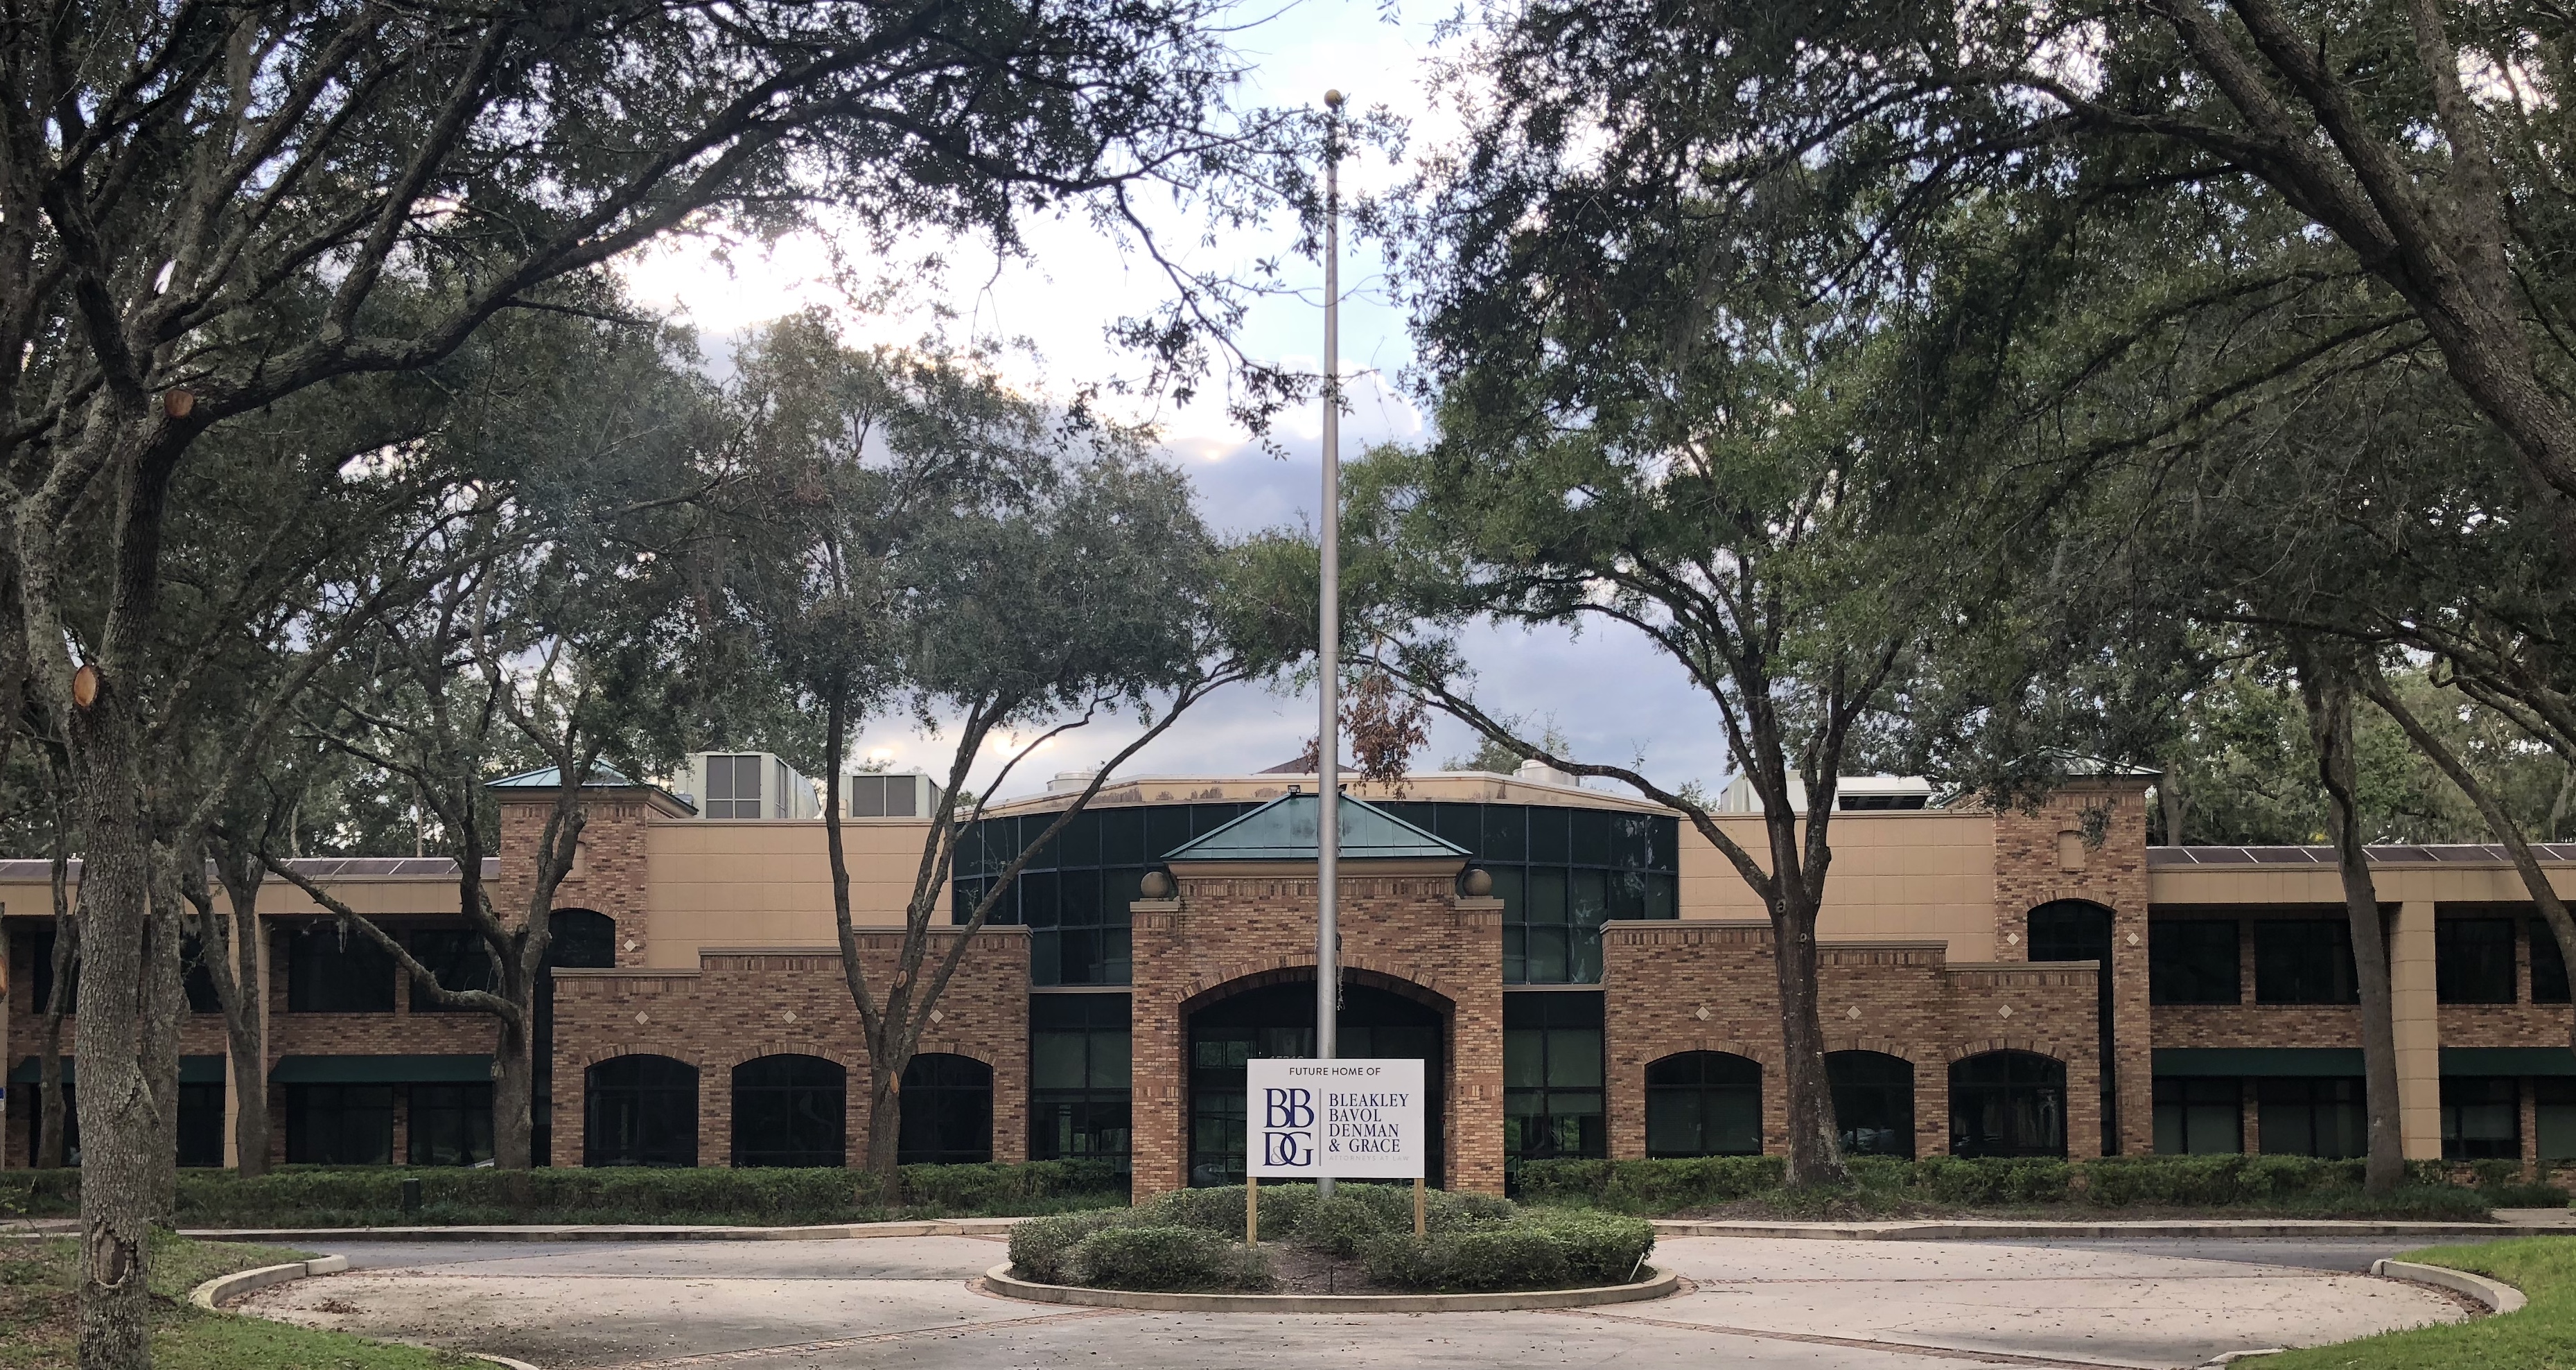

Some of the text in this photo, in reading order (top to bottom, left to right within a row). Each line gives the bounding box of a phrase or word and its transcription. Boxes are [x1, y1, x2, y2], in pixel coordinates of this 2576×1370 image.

[1289, 1067, 1381, 1075] FUTURE HOME OF
[1329, 1094, 1410, 1107] BLEAKLEY
[1263, 1088, 1315, 1128] BB
[1329, 1109, 1381, 1122] BAVOL
[1329, 1123, 1399, 1137] DENMAN
[1329, 1139, 1401, 1152] & GRACE
